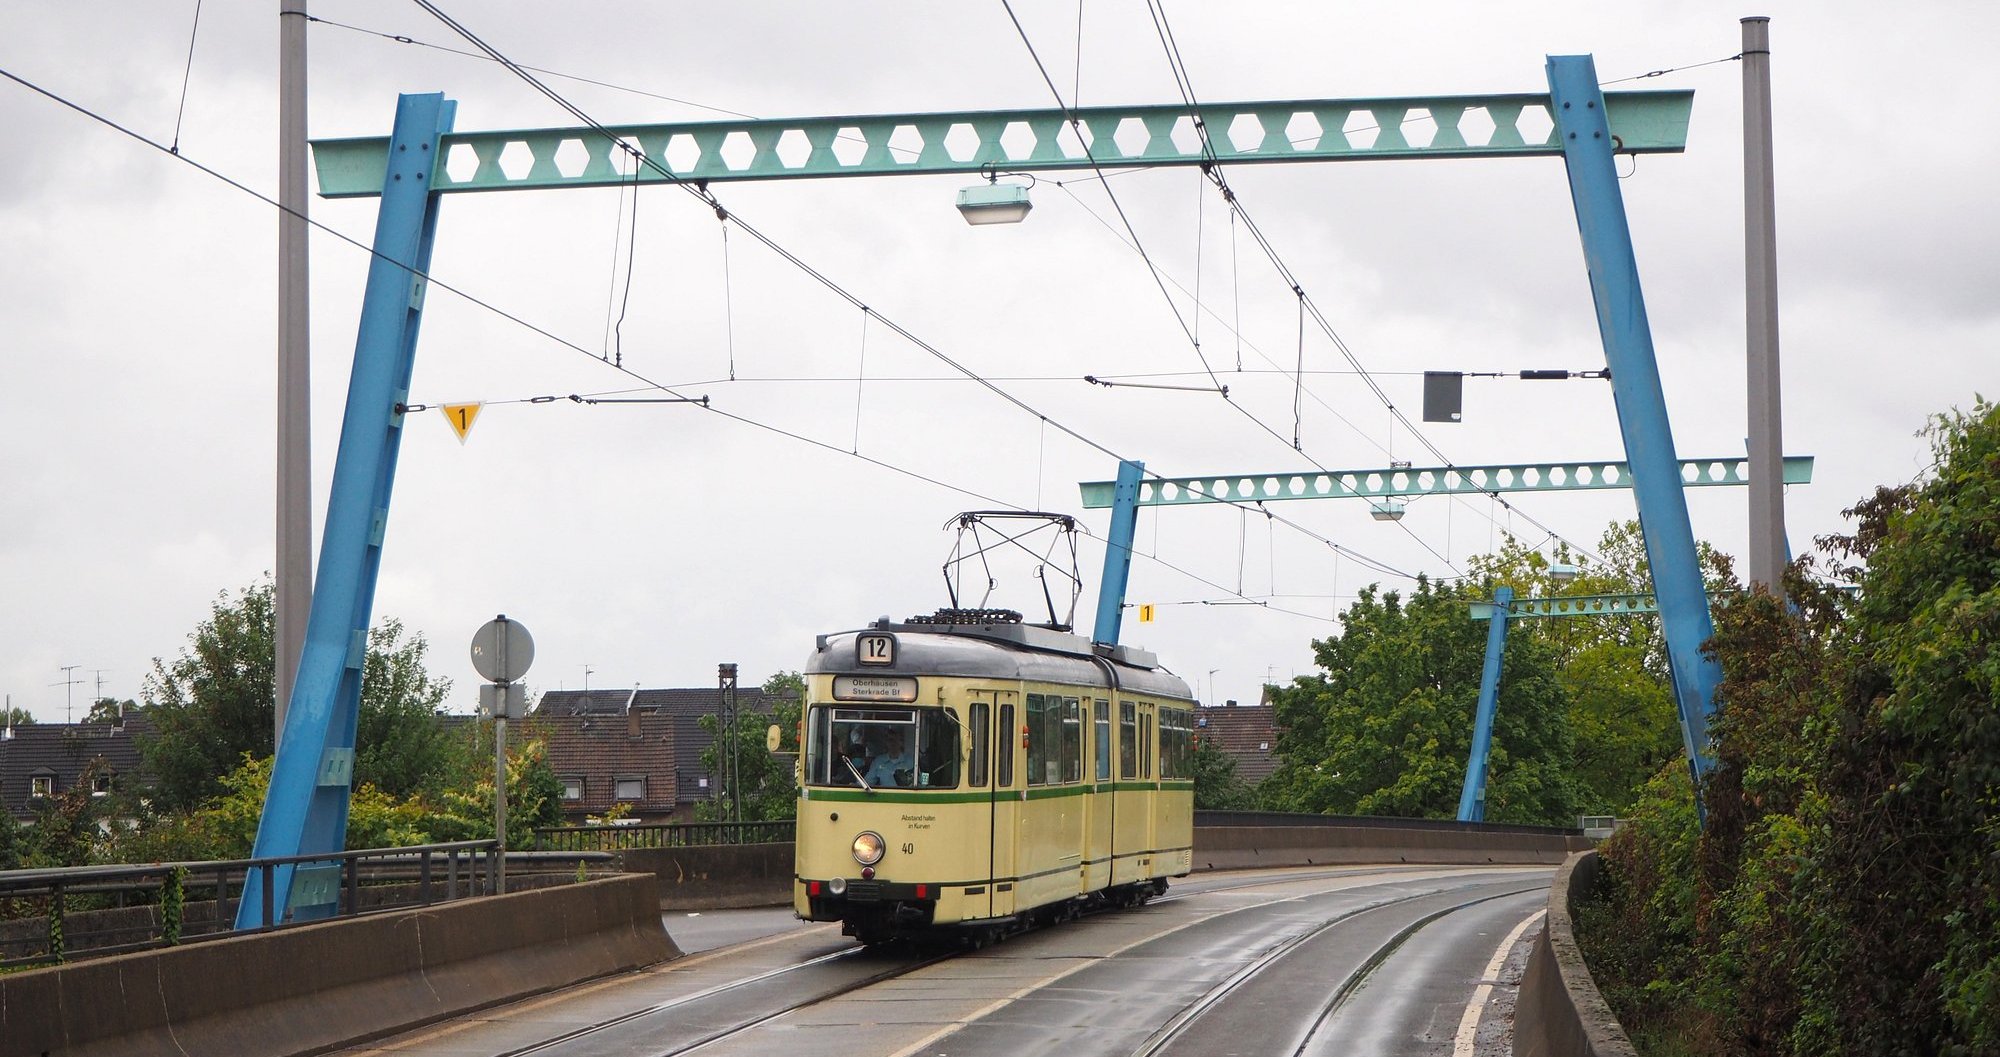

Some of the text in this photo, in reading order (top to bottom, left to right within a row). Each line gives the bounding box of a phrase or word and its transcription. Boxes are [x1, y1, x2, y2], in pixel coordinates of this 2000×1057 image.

[459, 408, 466, 430] 1
[1144, 605, 1150, 622] 1
[868, 638, 886, 658] 12
[852, 679, 898, 687] Oberhausen
[902, 842, 914, 854] 40
